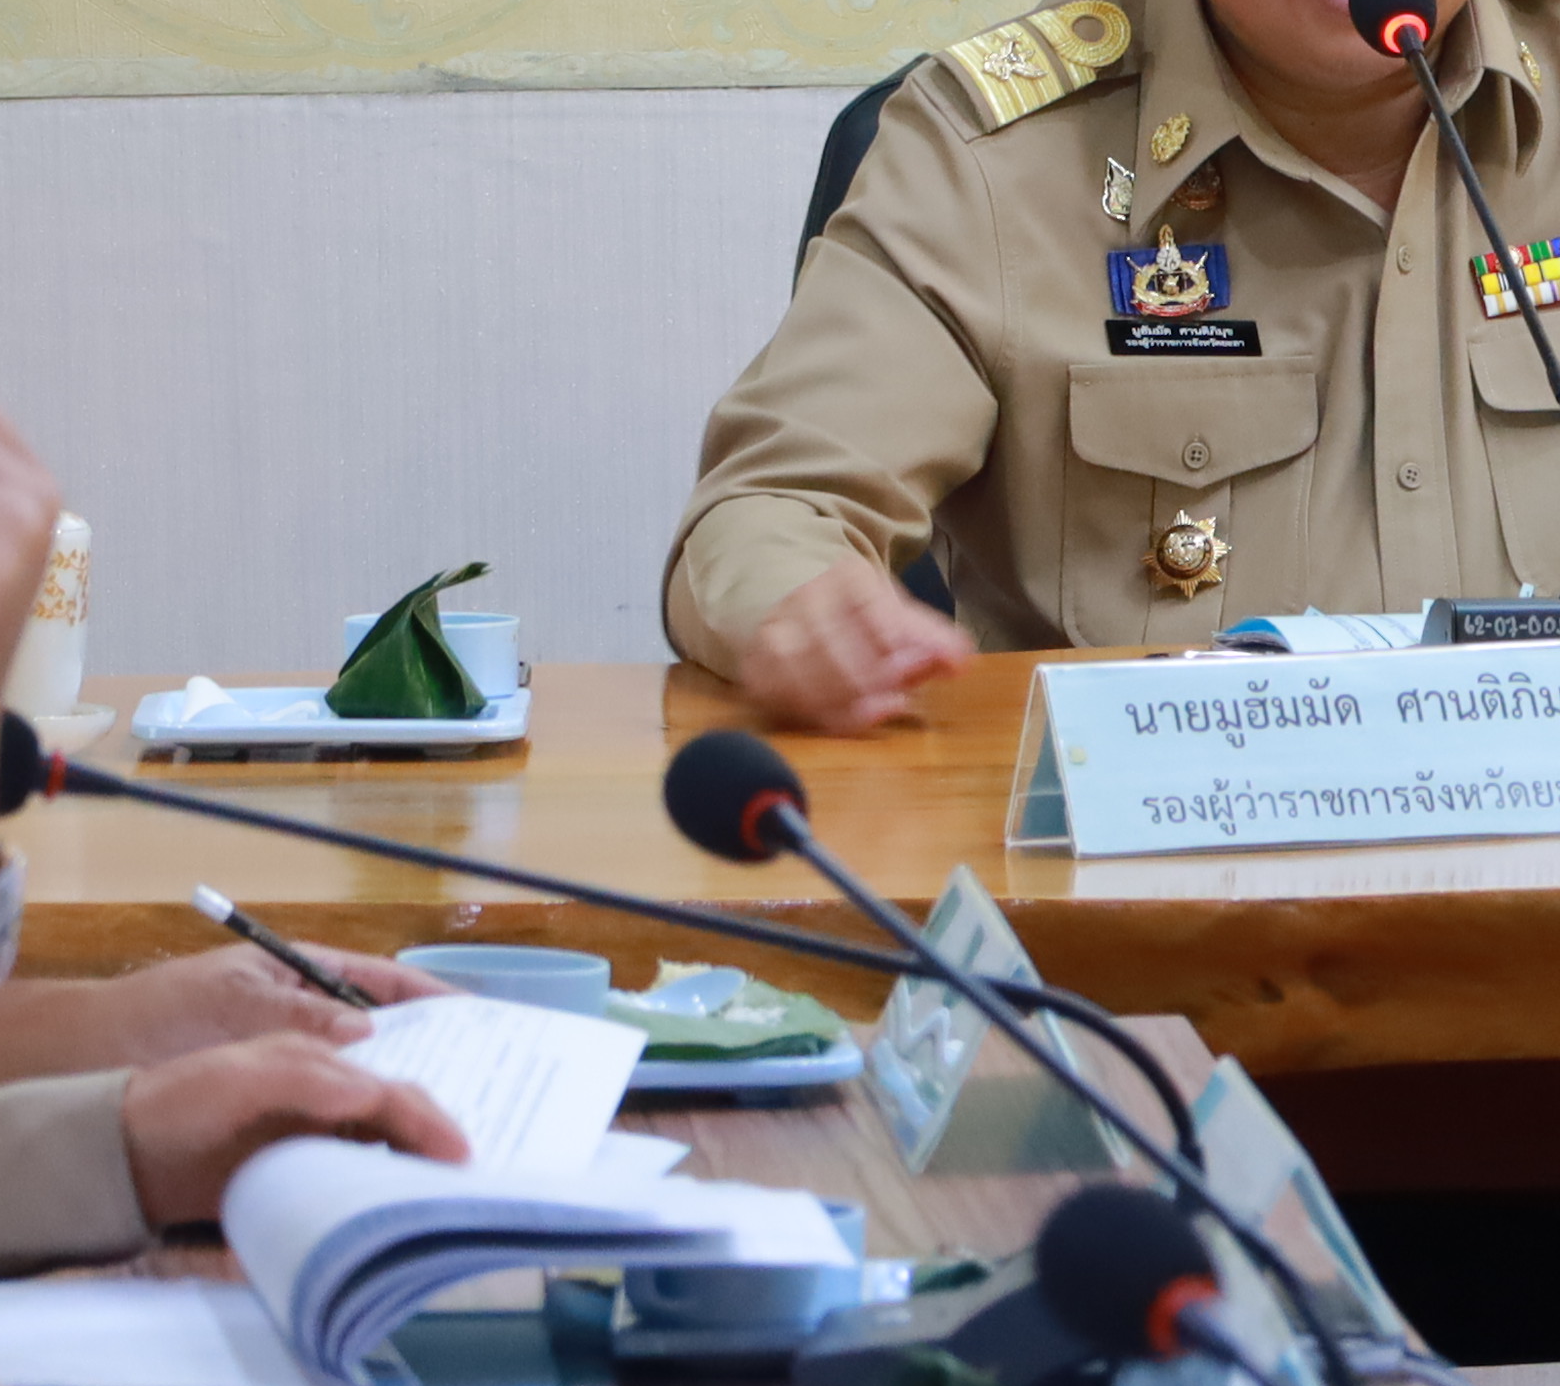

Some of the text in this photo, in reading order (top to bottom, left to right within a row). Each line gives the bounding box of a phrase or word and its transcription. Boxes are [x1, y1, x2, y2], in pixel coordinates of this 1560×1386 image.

[1124, 674, 1364, 749] นายมูฮัมมัด
